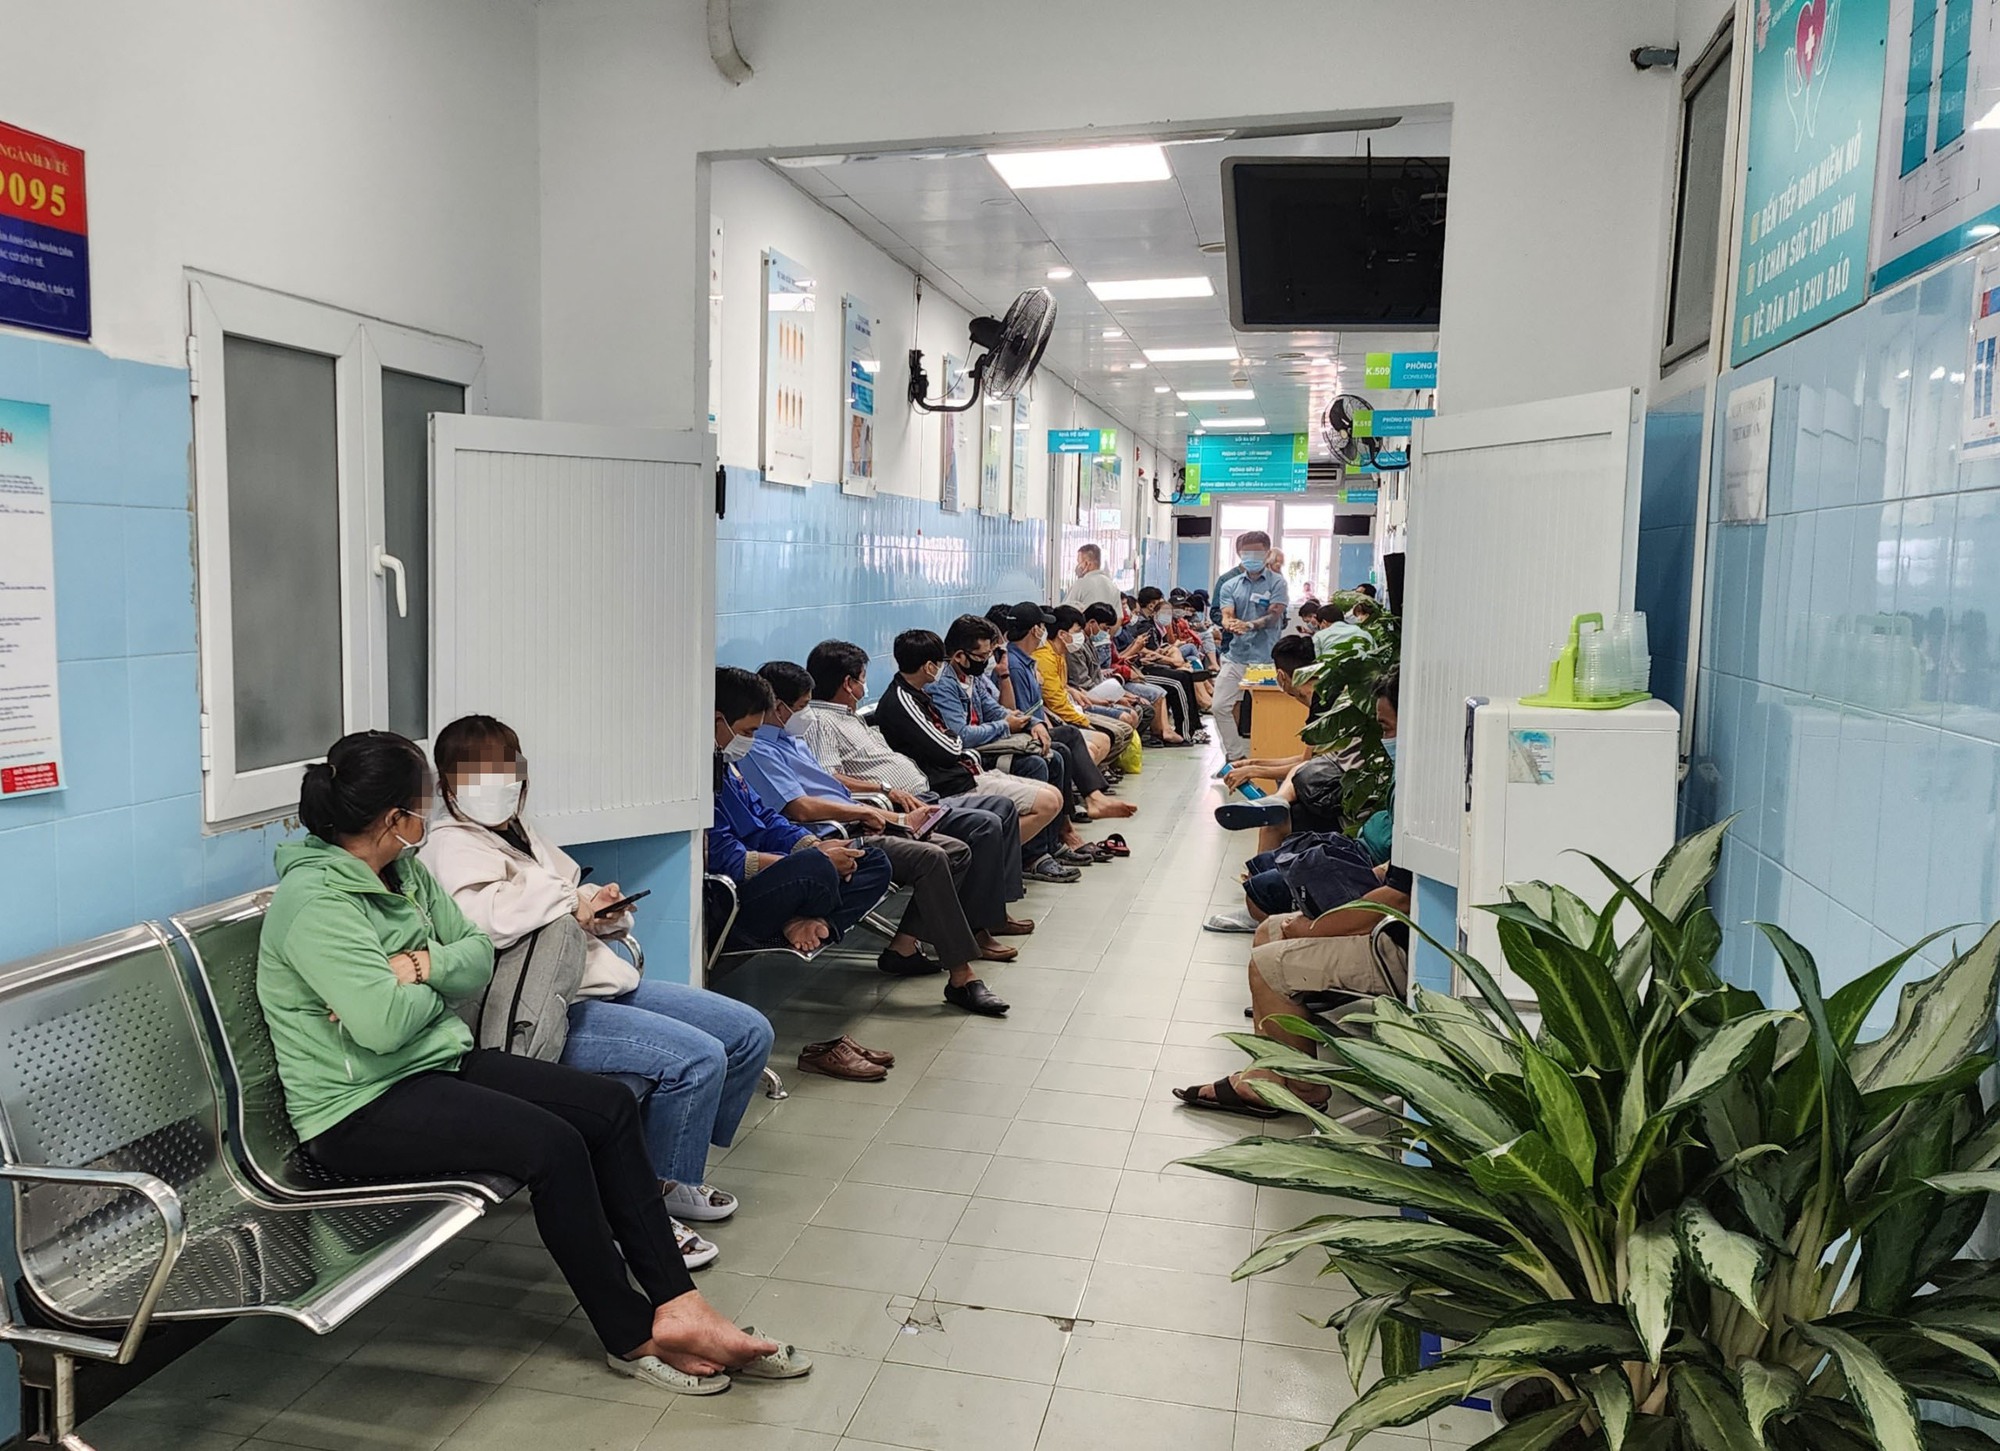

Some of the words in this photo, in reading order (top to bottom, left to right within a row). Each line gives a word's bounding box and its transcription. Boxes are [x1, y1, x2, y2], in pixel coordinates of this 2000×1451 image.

[1778, 175, 1798, 224] TIẾP
[1789, 221, 1809, 267] SÓC
[1810, 211, 1829, 256] TẬN
[1831, 192, 1856, 239] TÌNH
[1786, 278, 1800, 323] DÒ
[1802, 271, 1824, 313] CHU
[1365, 367, 1390, 376] K.509
[1405, 360, 1433, 370] PHÒNG
